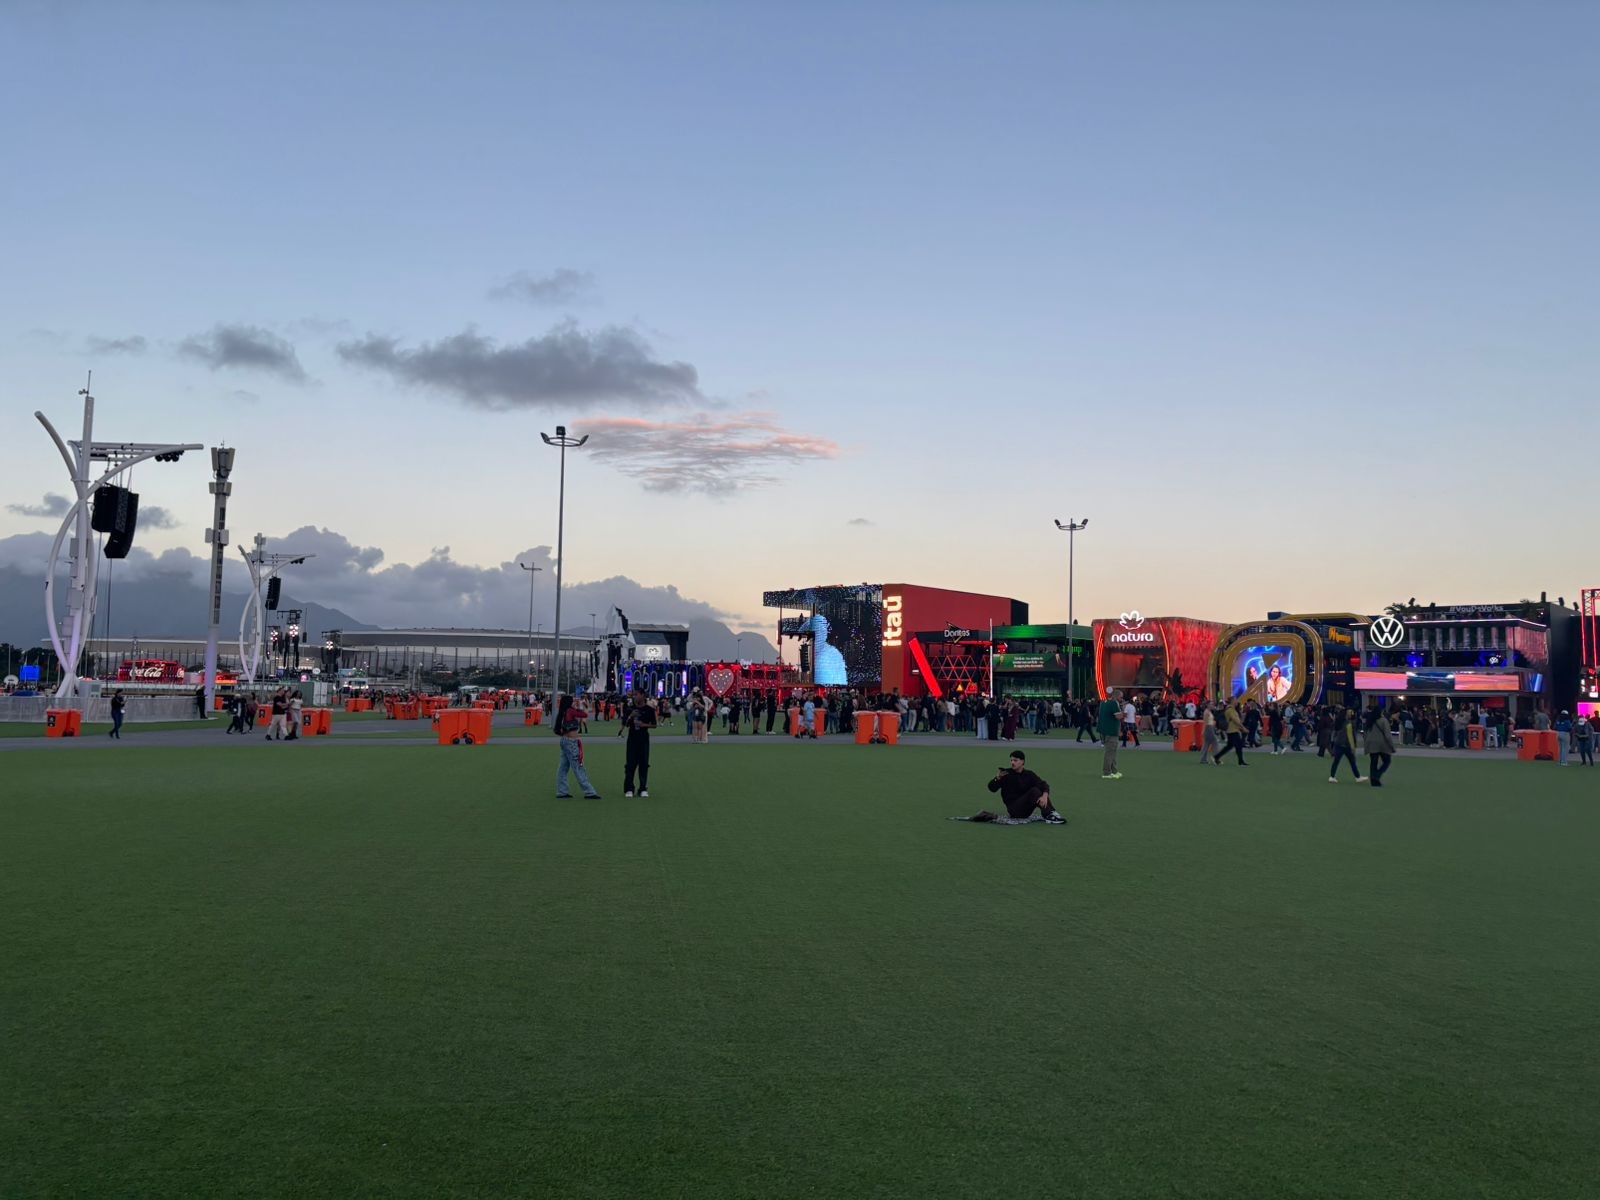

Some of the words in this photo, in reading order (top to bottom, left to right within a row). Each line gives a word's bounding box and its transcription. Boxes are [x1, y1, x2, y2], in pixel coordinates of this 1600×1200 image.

[882, 595, 902, 646] itaú
[944, 629, 970, 637] Doritos
[1111, 632, 1153, 642] natura
[1370, 617, 1404, 648] VW
